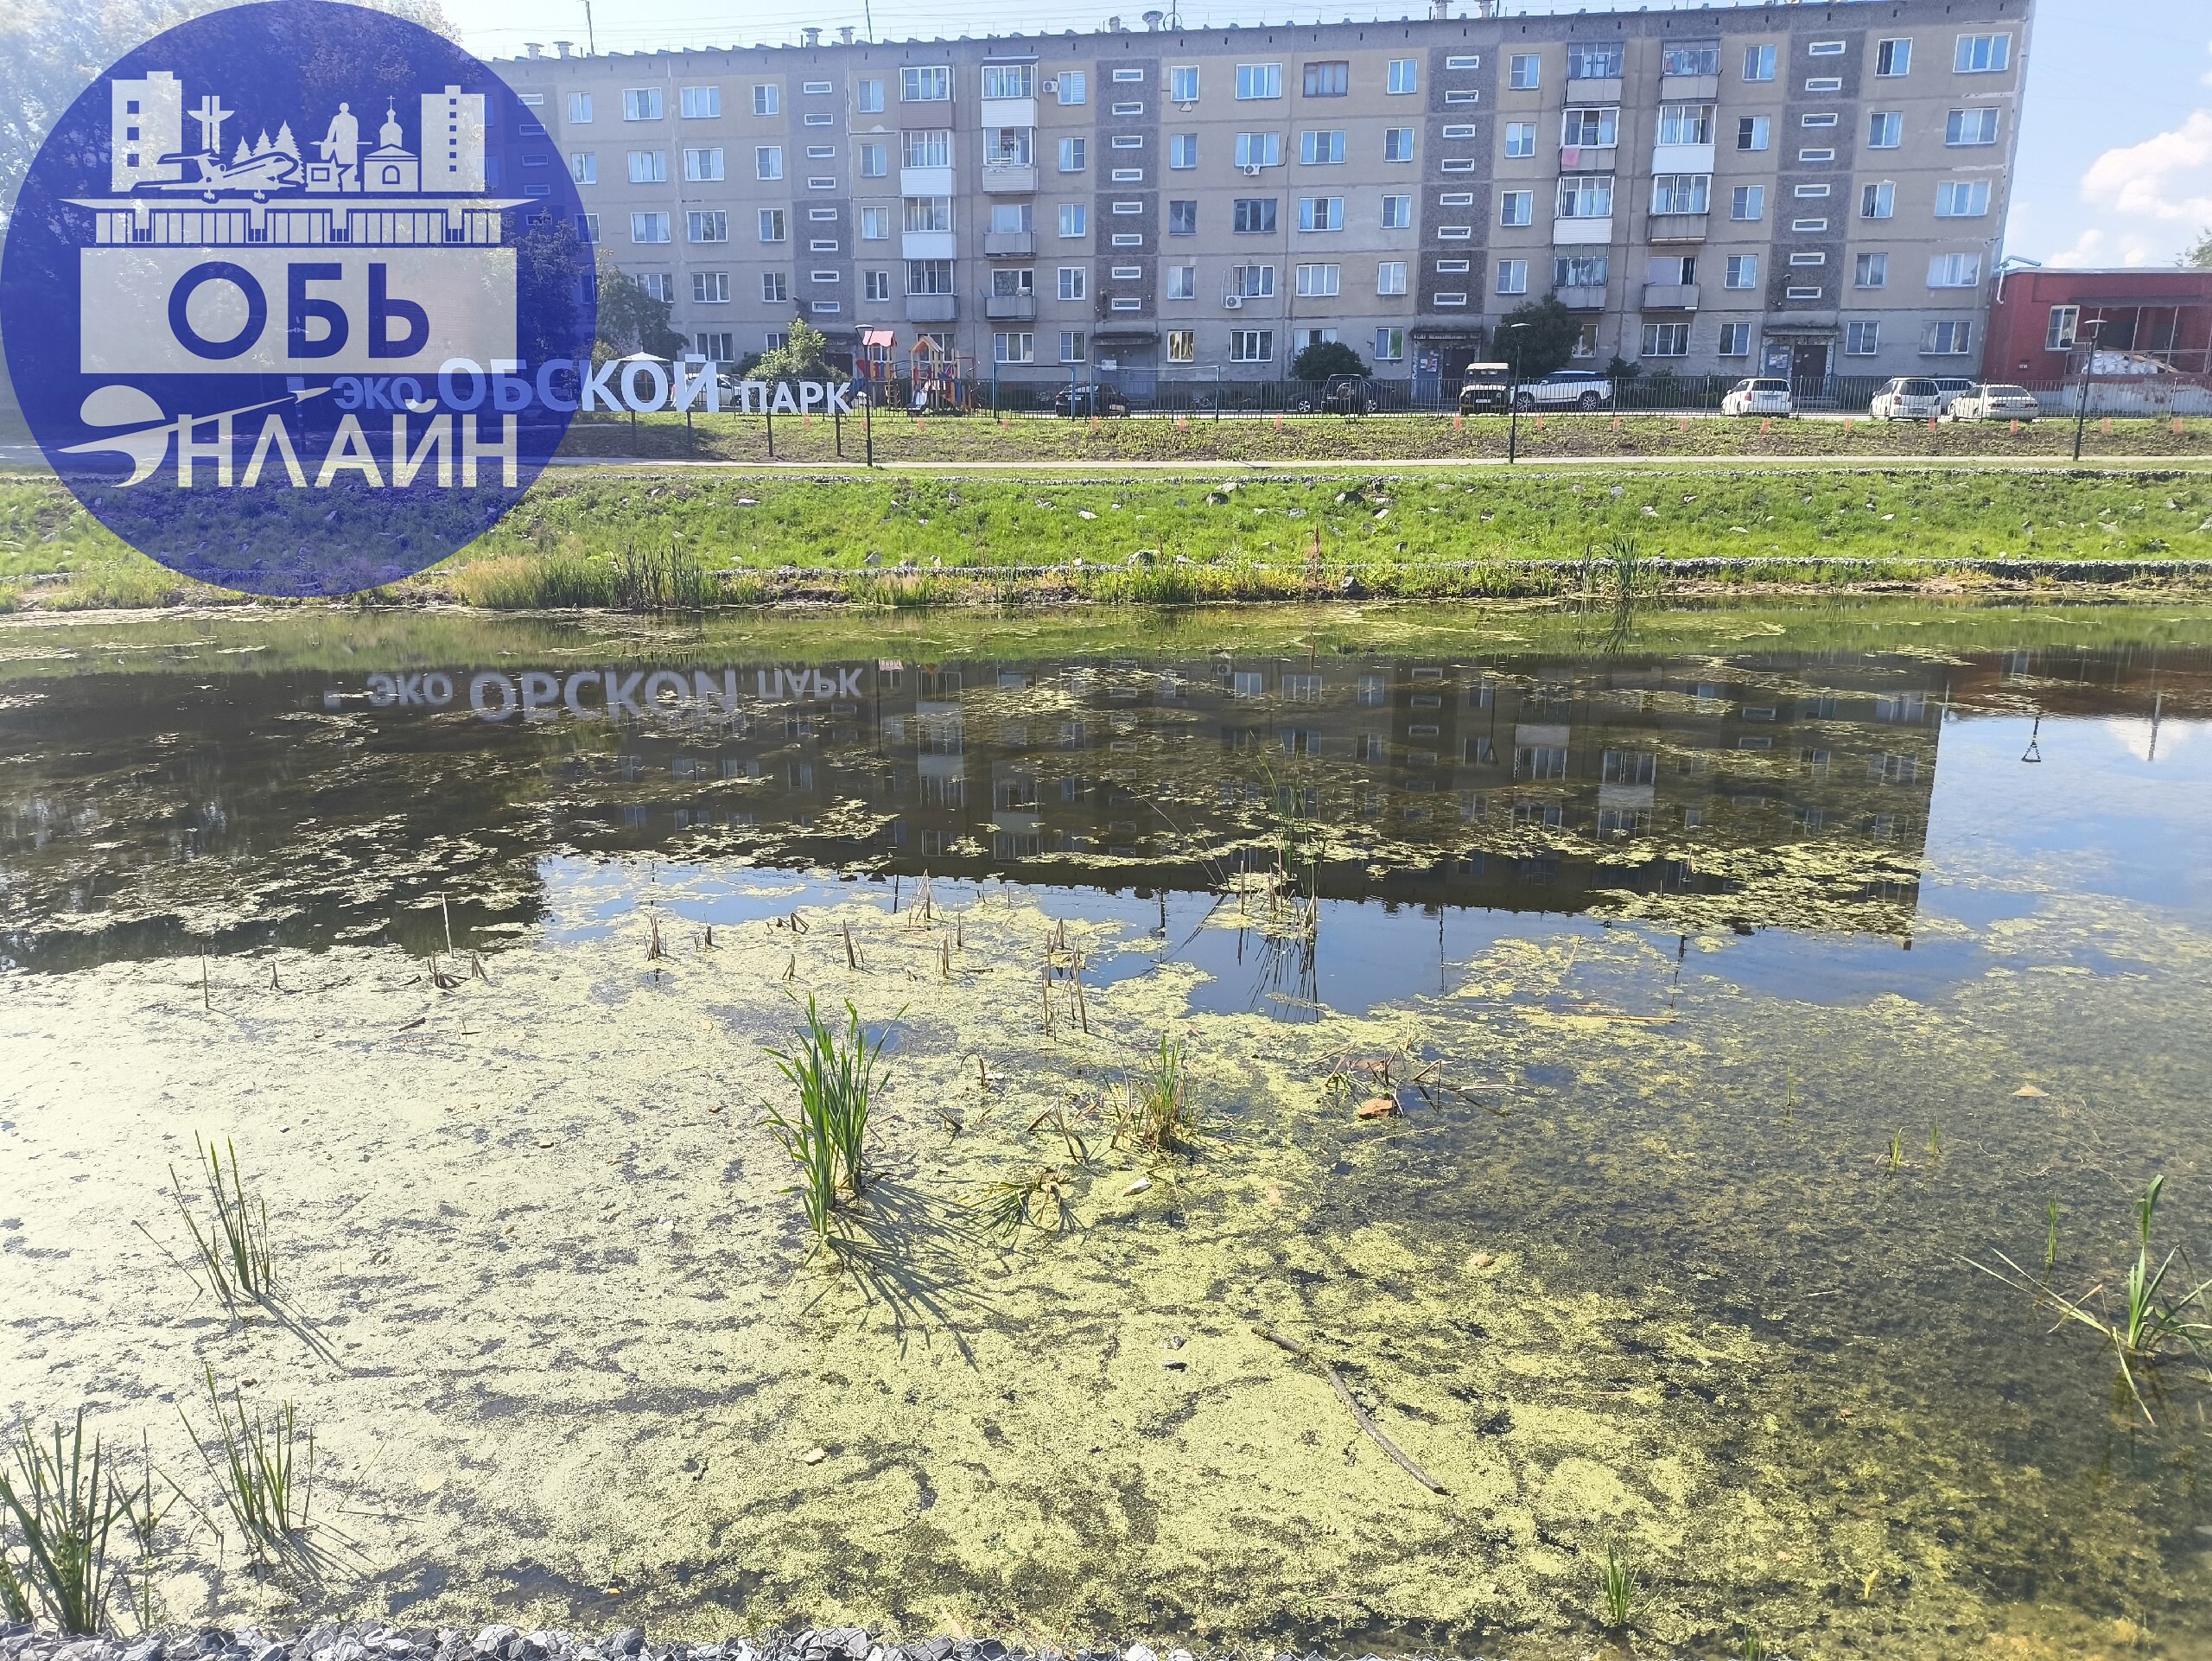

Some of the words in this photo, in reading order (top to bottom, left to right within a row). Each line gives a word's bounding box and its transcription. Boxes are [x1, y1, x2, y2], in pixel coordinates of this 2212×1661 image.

[333, 376, 423, 410] ЭКО
[437, 354, 719, 413] ОБСКОЙ
[741, 381, 854, 415] ПАРК
